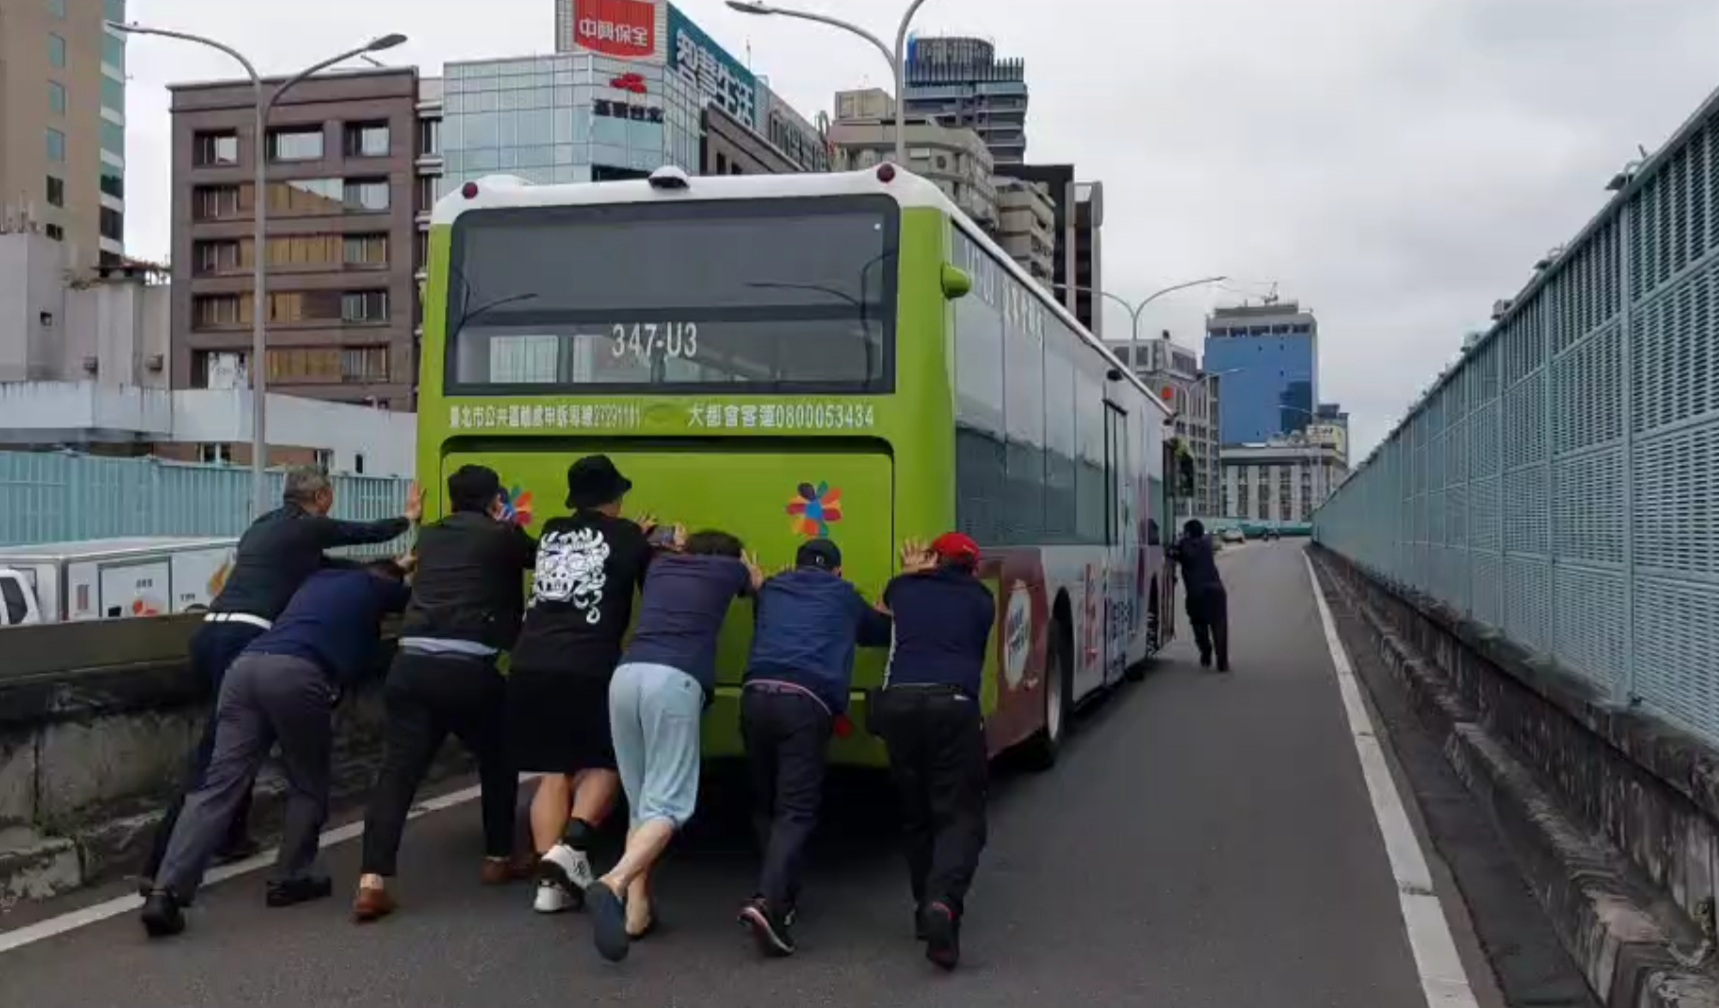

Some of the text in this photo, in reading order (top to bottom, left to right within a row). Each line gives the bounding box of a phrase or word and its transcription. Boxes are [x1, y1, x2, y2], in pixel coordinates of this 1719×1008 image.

[579, 19, 648, 47] 中興保全
[676, 28, 753, 129] 智慧生活
[611, 321, 697, 358] 347-U3
